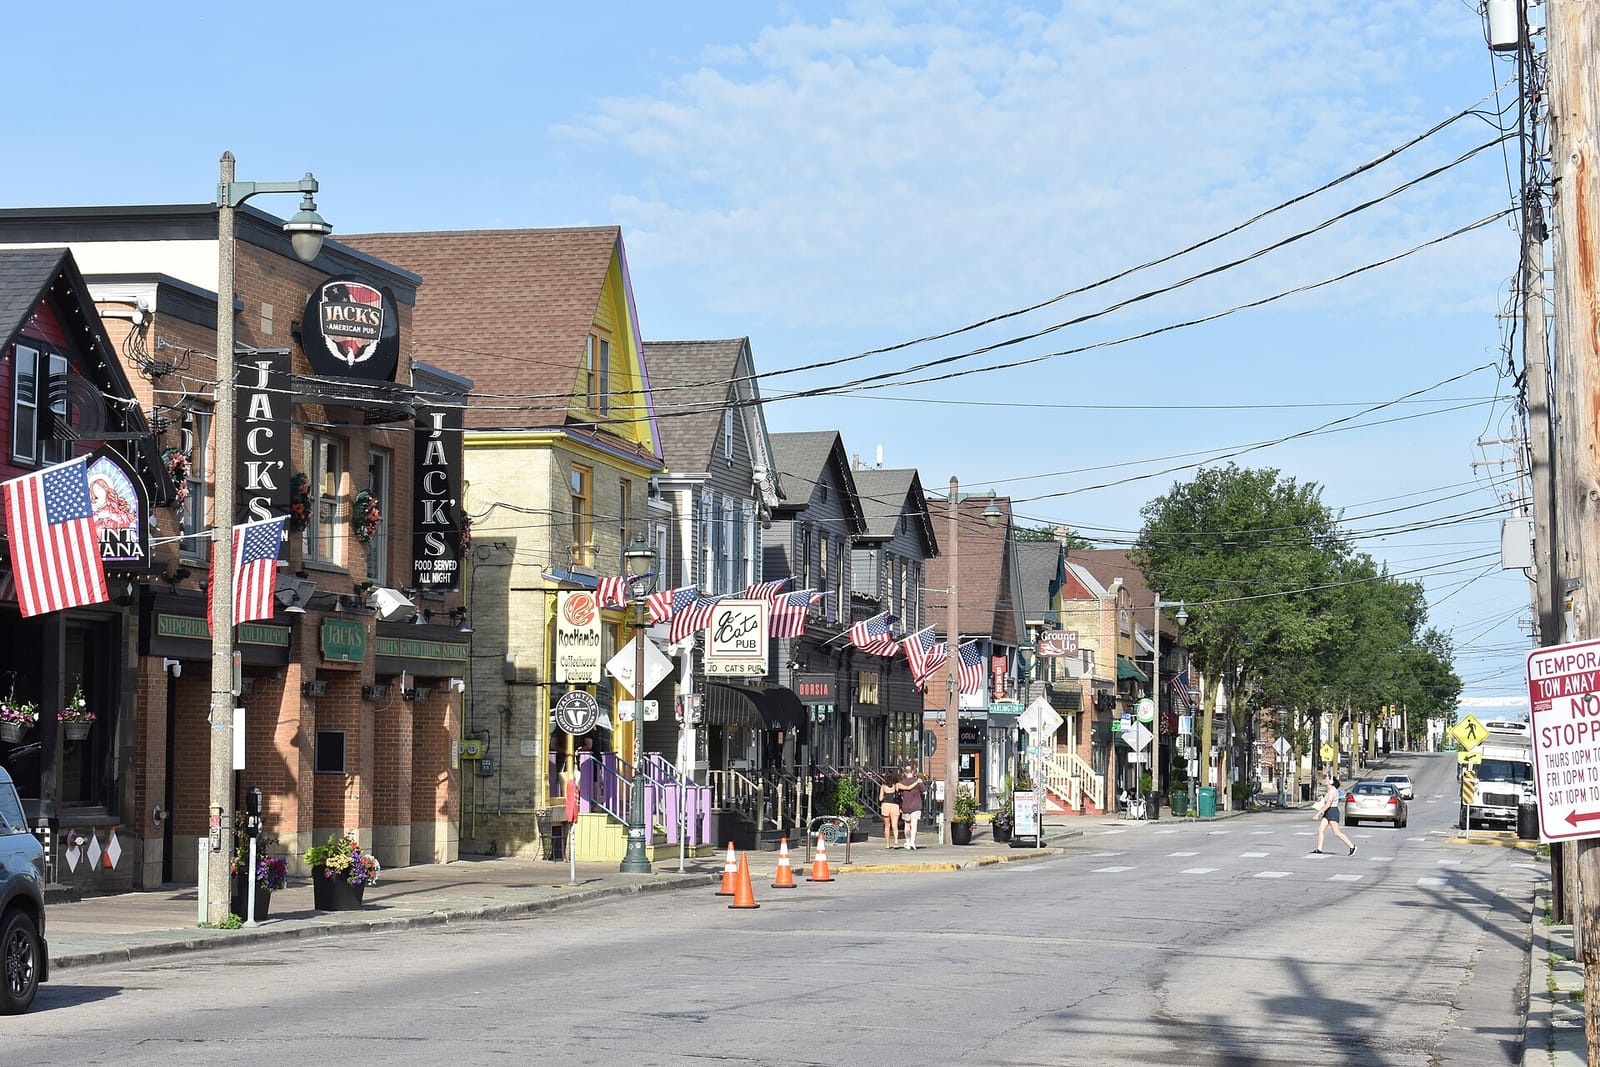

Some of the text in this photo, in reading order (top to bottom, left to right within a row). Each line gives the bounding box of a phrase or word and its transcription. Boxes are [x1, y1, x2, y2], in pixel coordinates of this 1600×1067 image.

[325, 305, 380, 326] JACK'S
[328, 323, 361, 333] AMERICAN
[244, 360, 284, 524] JACK'S
[422, 412, 456, 556] JACK'S
[101, 528, 136, 543] INT
[102, 543, 144, 557] ANA
[414, 559, 457, 571] FOOD SERVED
[419, 572, 452, 584] ALL NIGHT
[1040, 631, 1076, 641] Ground
[735, 640, 757, 649] PUB
[1061, 641, 1077, 652] Up
[708, 664, 718, 673] JO
[725, 664, 745, 673] CAT'S
[1535, 652, 1600, 676] TEMPOR
[799, 683, 829, 696] DORSIA
[1538, 673, 1596, 699] TOW AWAY
[558, 693, 596, 710] VALENTINE
[1571, 694, 1600, 719] NO
[1545, 751, 1570, 768] THURS
[1572, 748, 1592, 766] 10PM
[1546, 766, 1599, 788] FRI 10PM TO
[1549, 785, 1600, 807] SAT 10PM TO
